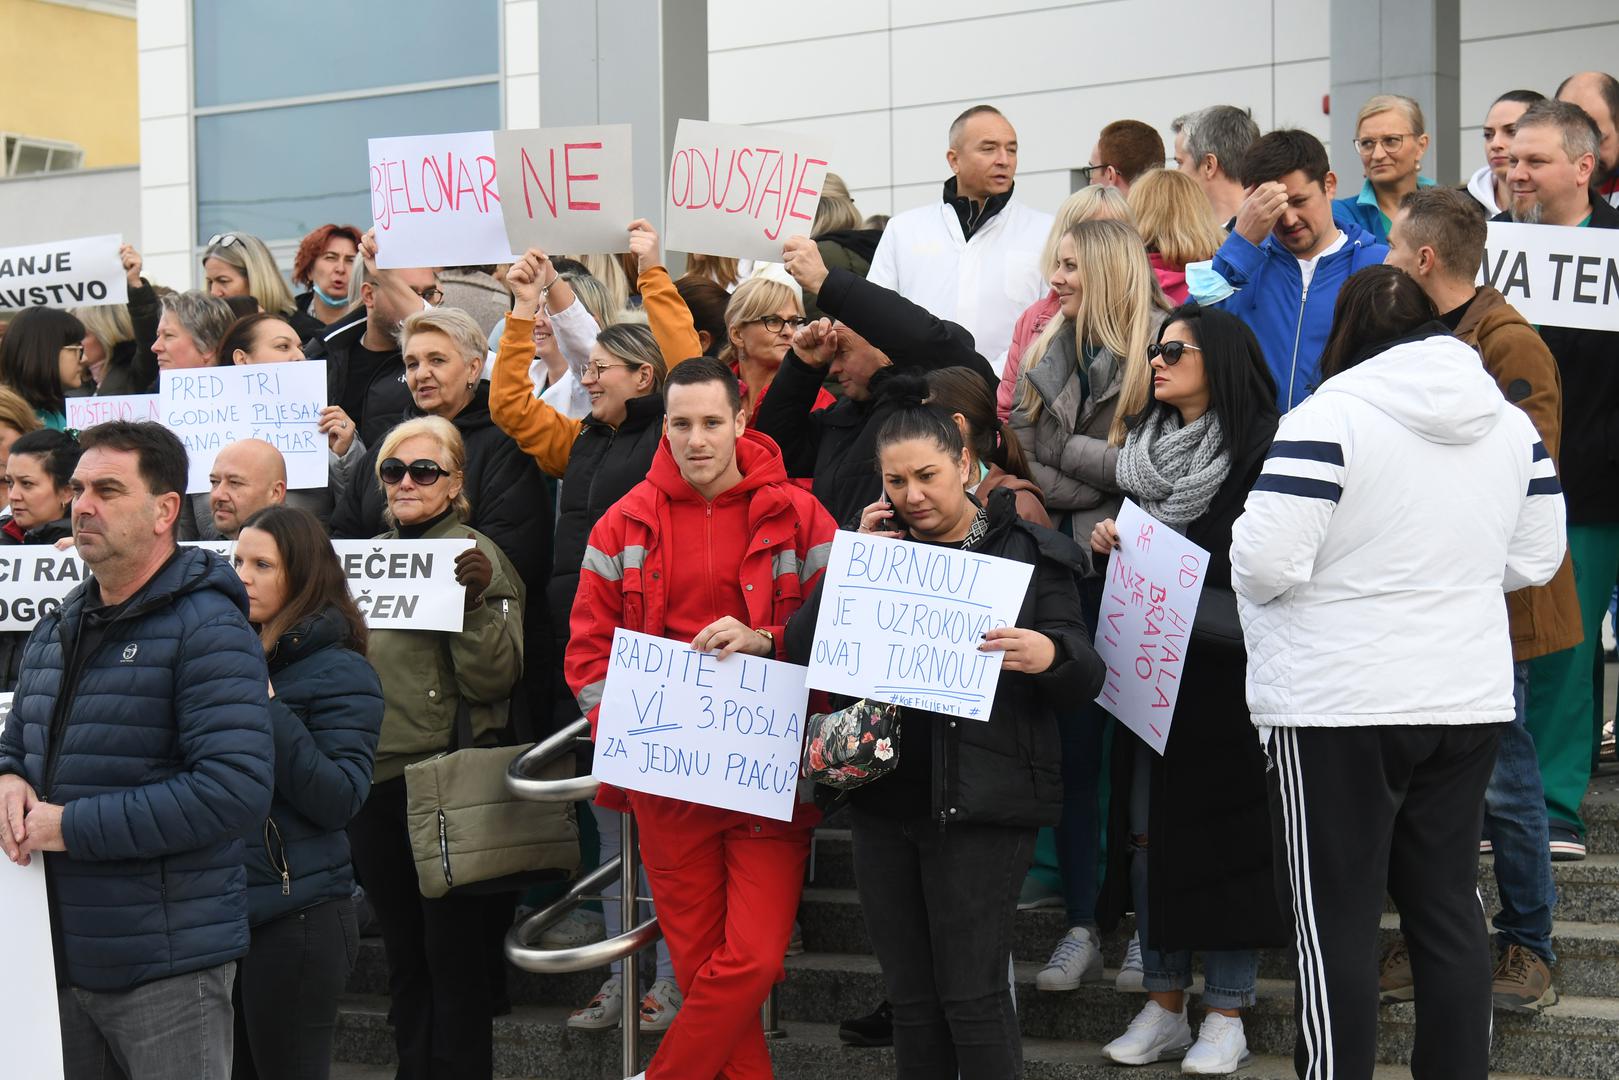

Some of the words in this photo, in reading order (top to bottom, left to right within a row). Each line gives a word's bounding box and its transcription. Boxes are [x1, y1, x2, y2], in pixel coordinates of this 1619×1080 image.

[369, 151, 501, 231] BJELOVAR
[521, 142, 603, 219] NE
[671, 147, 828, 241] ODUSTAJE
[0, 251, 72, 278] ANJE
[171, 375, 224, 401] PRED
[242, 368, 281, 395] TRI
[69, 399, 133, 428] POŠTENO
[168, 403, 240, 427] GODINE
[252, 402, 321, 429] PLJESAK
[184, 431, 237, 452] ANAS
[251, 428, 318, 451] AMAR
[1136, 523, 1155, 553] SE
[343, 547, 434, 579] EČEN
[846, 541, 992, 600] BURNOUT
[1178, 554, 1200, 589] OD
[832, 591, 857, 627] JE
[1130, 571, 1146, 608] NE
[1134, 581, 1168, 681] BRAVO
[615, 636, 719, 688] RADITE
[739, 659, 768, 693] LI
[815, 639, 863, 677] OVAJ
[886, 643, 994, 690] TURNOUT
[1151, 607, 1188, 709] HVALA
[631, 684, 665, 726] VI
[602, 737, 628, 759] ZA
[638, 741, 711, 777] JEDNU
[724, 752, 799, 794] PLAĆU?
